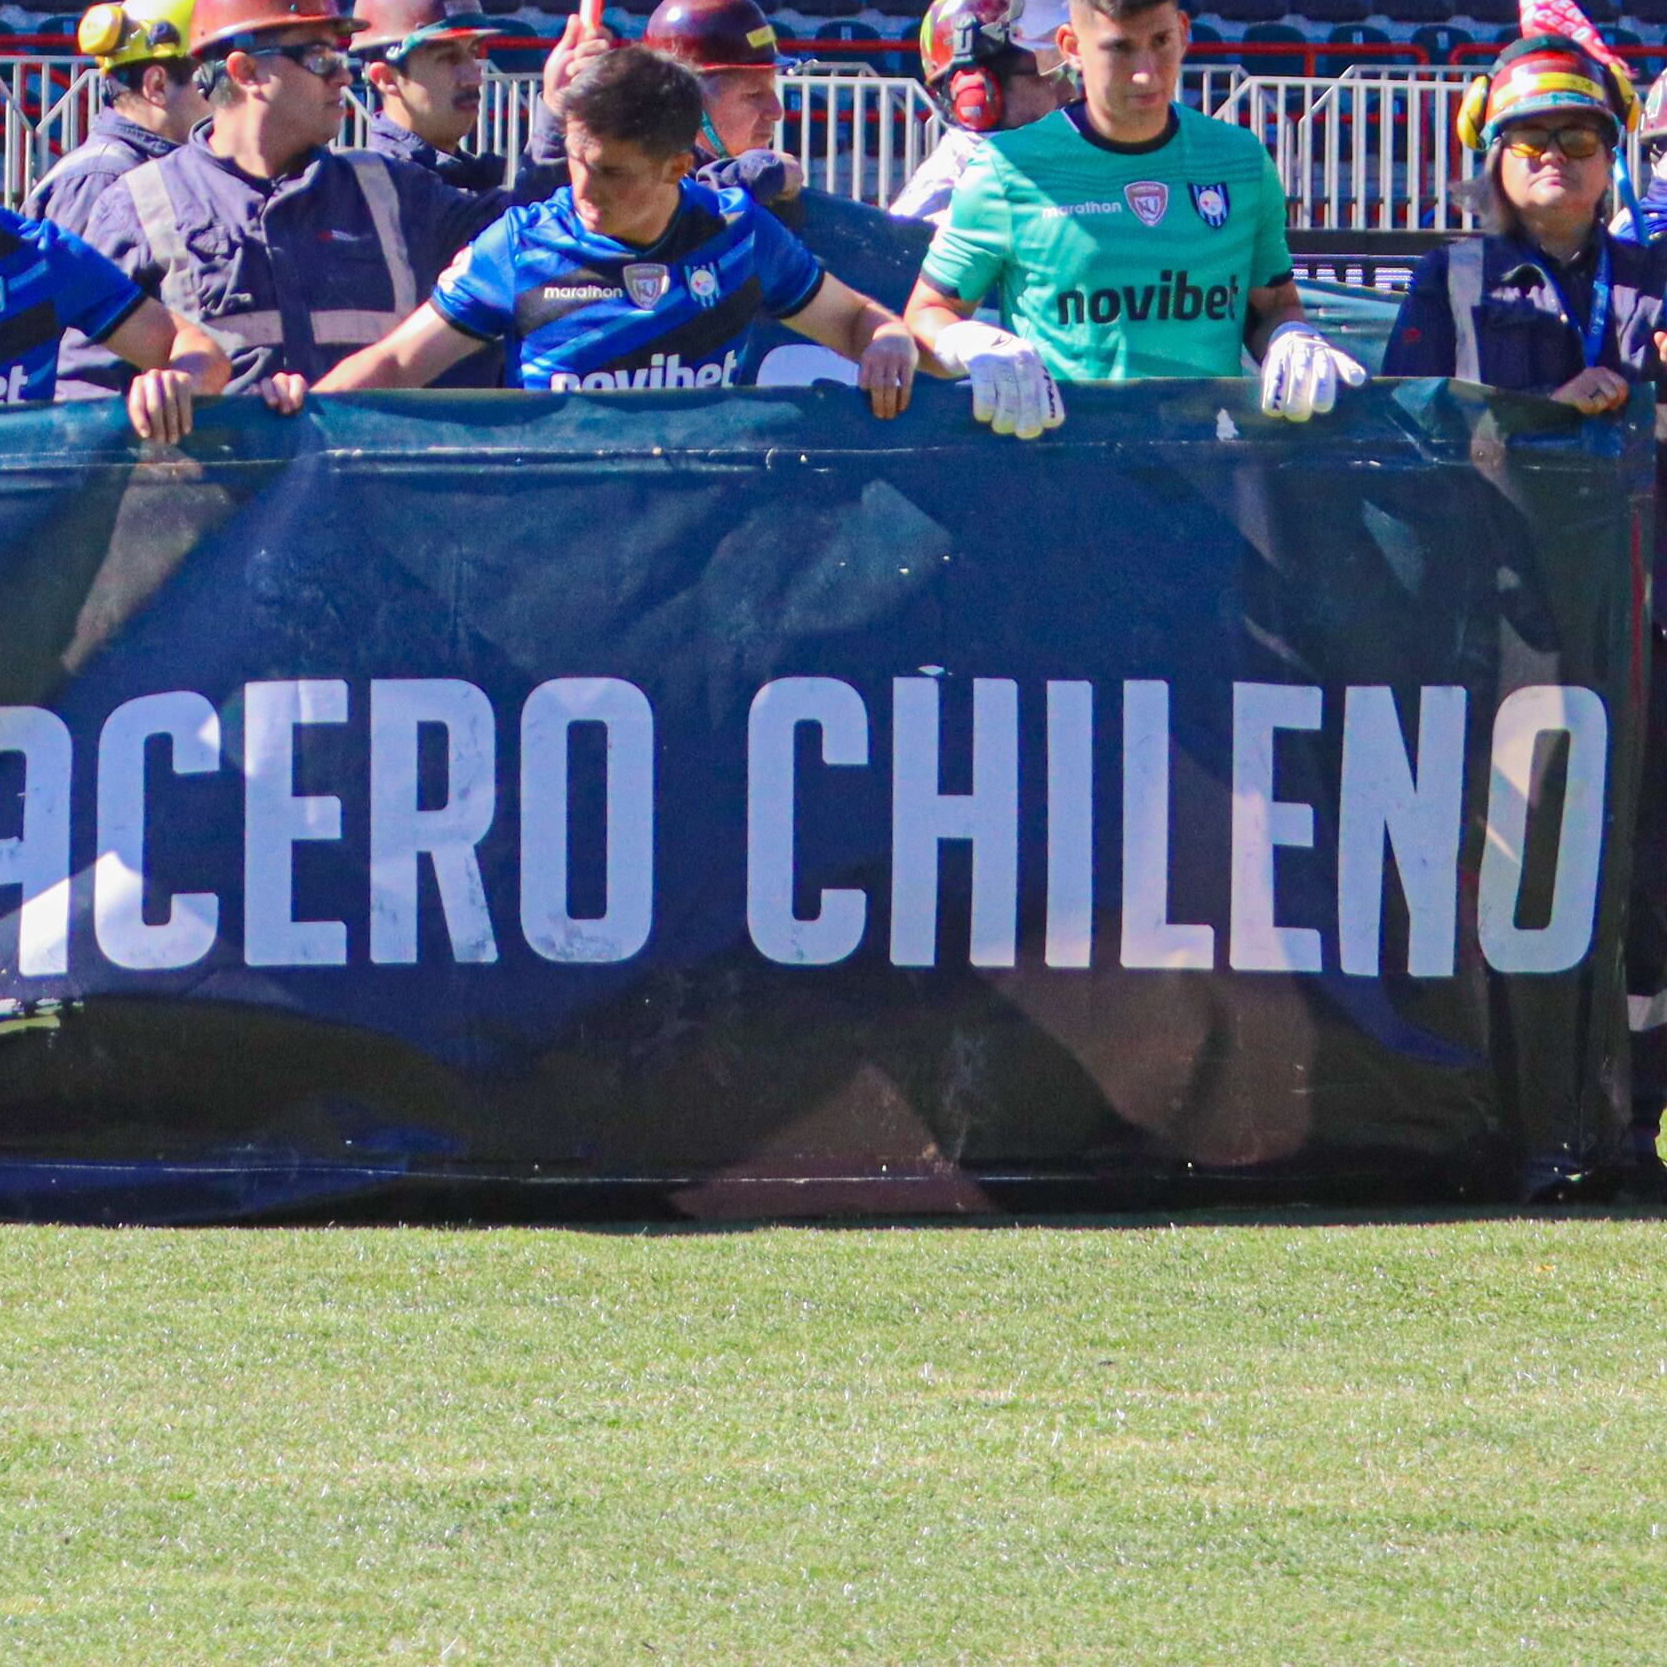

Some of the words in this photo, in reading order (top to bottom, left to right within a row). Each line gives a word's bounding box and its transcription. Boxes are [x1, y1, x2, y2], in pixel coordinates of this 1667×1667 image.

[1043, 200, 1122, 219] marathon
[543, 284, 623, 300] marathon
[1056, 270, 1239, 328] novibet
[746, 675, 1612, 978] CHILENO
